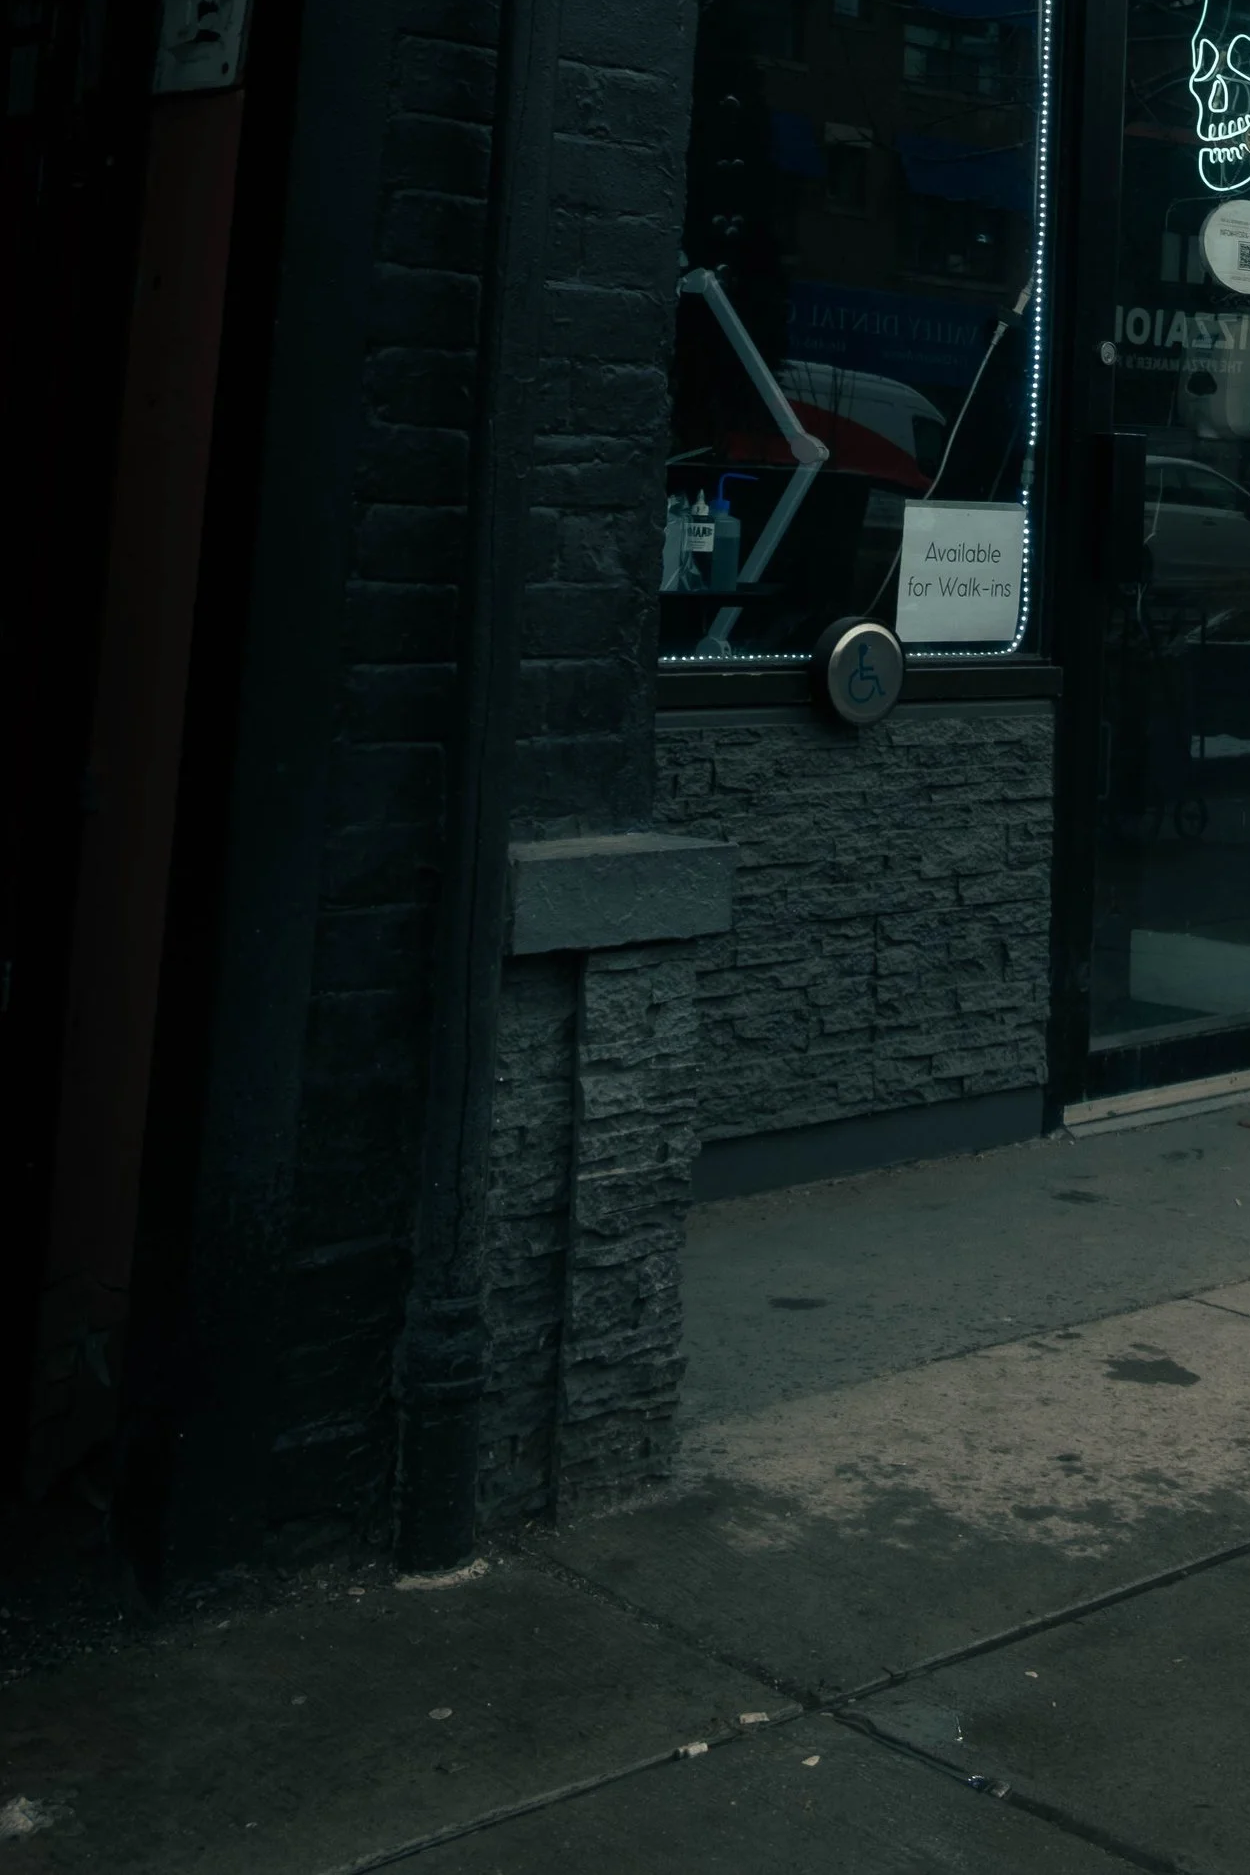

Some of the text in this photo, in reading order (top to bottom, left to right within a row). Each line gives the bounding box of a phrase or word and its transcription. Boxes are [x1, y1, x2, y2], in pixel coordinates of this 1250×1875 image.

[925, 542, 1001, 563] Available
[908, 576, 1012, 597] for Walk-ins
